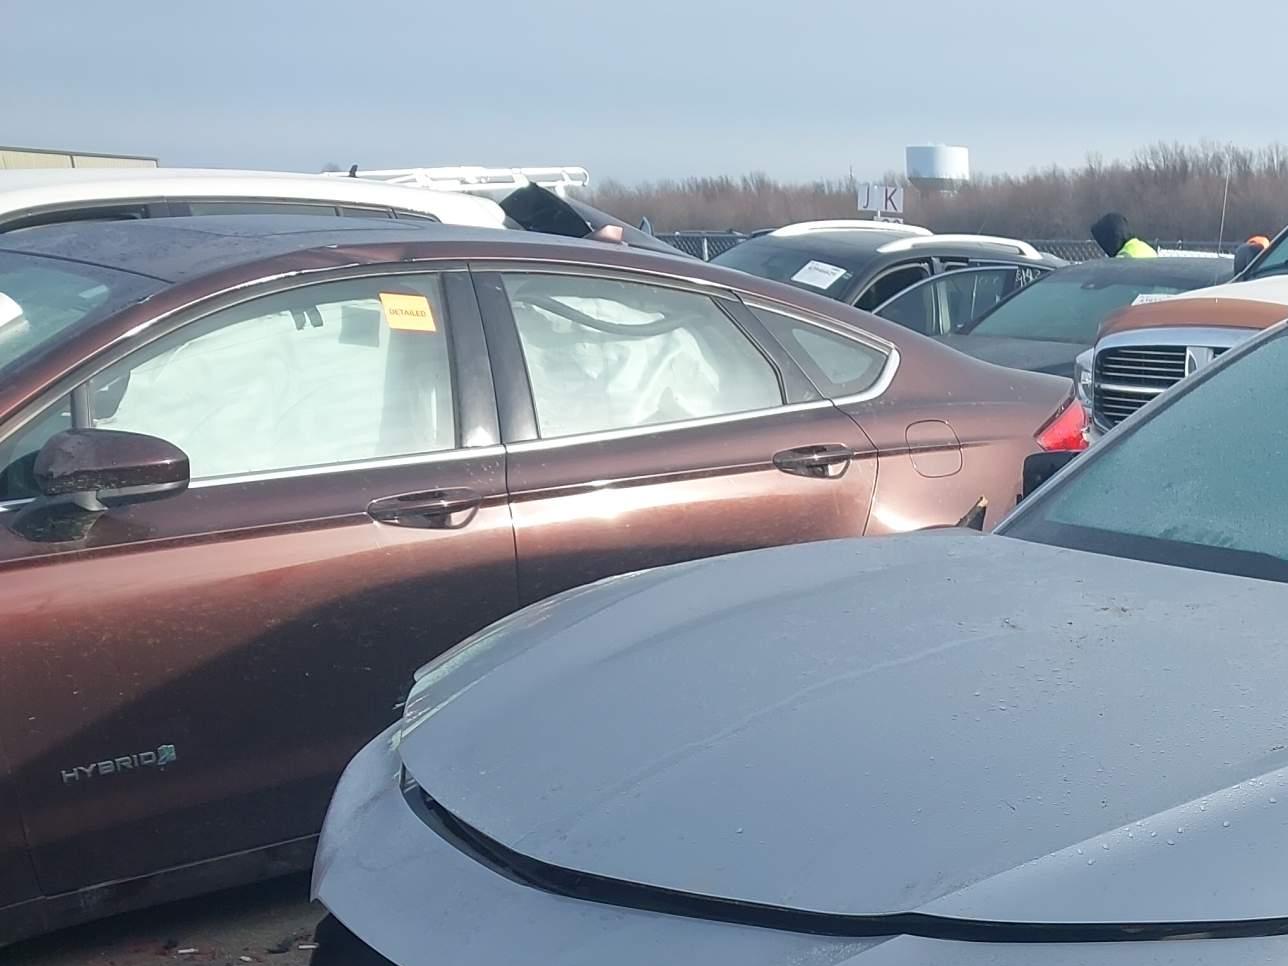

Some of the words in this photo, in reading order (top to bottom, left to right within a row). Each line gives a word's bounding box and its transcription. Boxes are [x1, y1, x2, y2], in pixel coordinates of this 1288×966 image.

[862, 183, 871, 209] J
[884, 186, 898, 212] K
[60, 751, 157, 783] HYBRID
